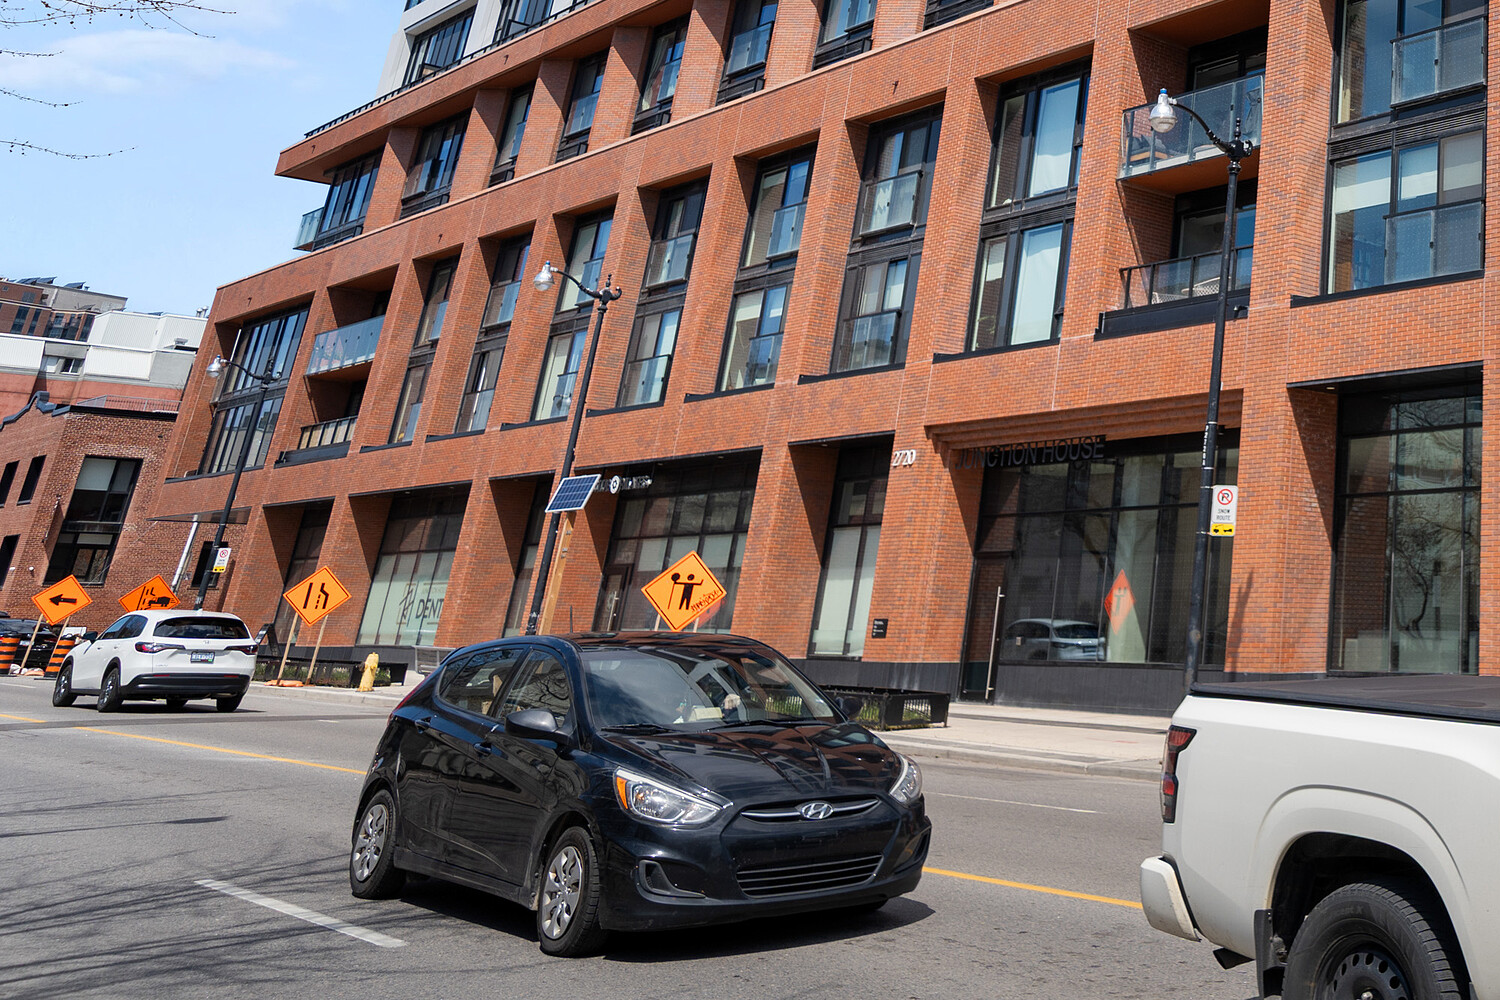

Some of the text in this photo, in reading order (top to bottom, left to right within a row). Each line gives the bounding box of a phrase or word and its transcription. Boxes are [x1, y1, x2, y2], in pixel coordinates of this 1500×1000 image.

[892, 449, 916, 466] 2720
[955, 436, 1105, 469] JUNCTION HOUSE
[415, 598, 444, 619] DENT
